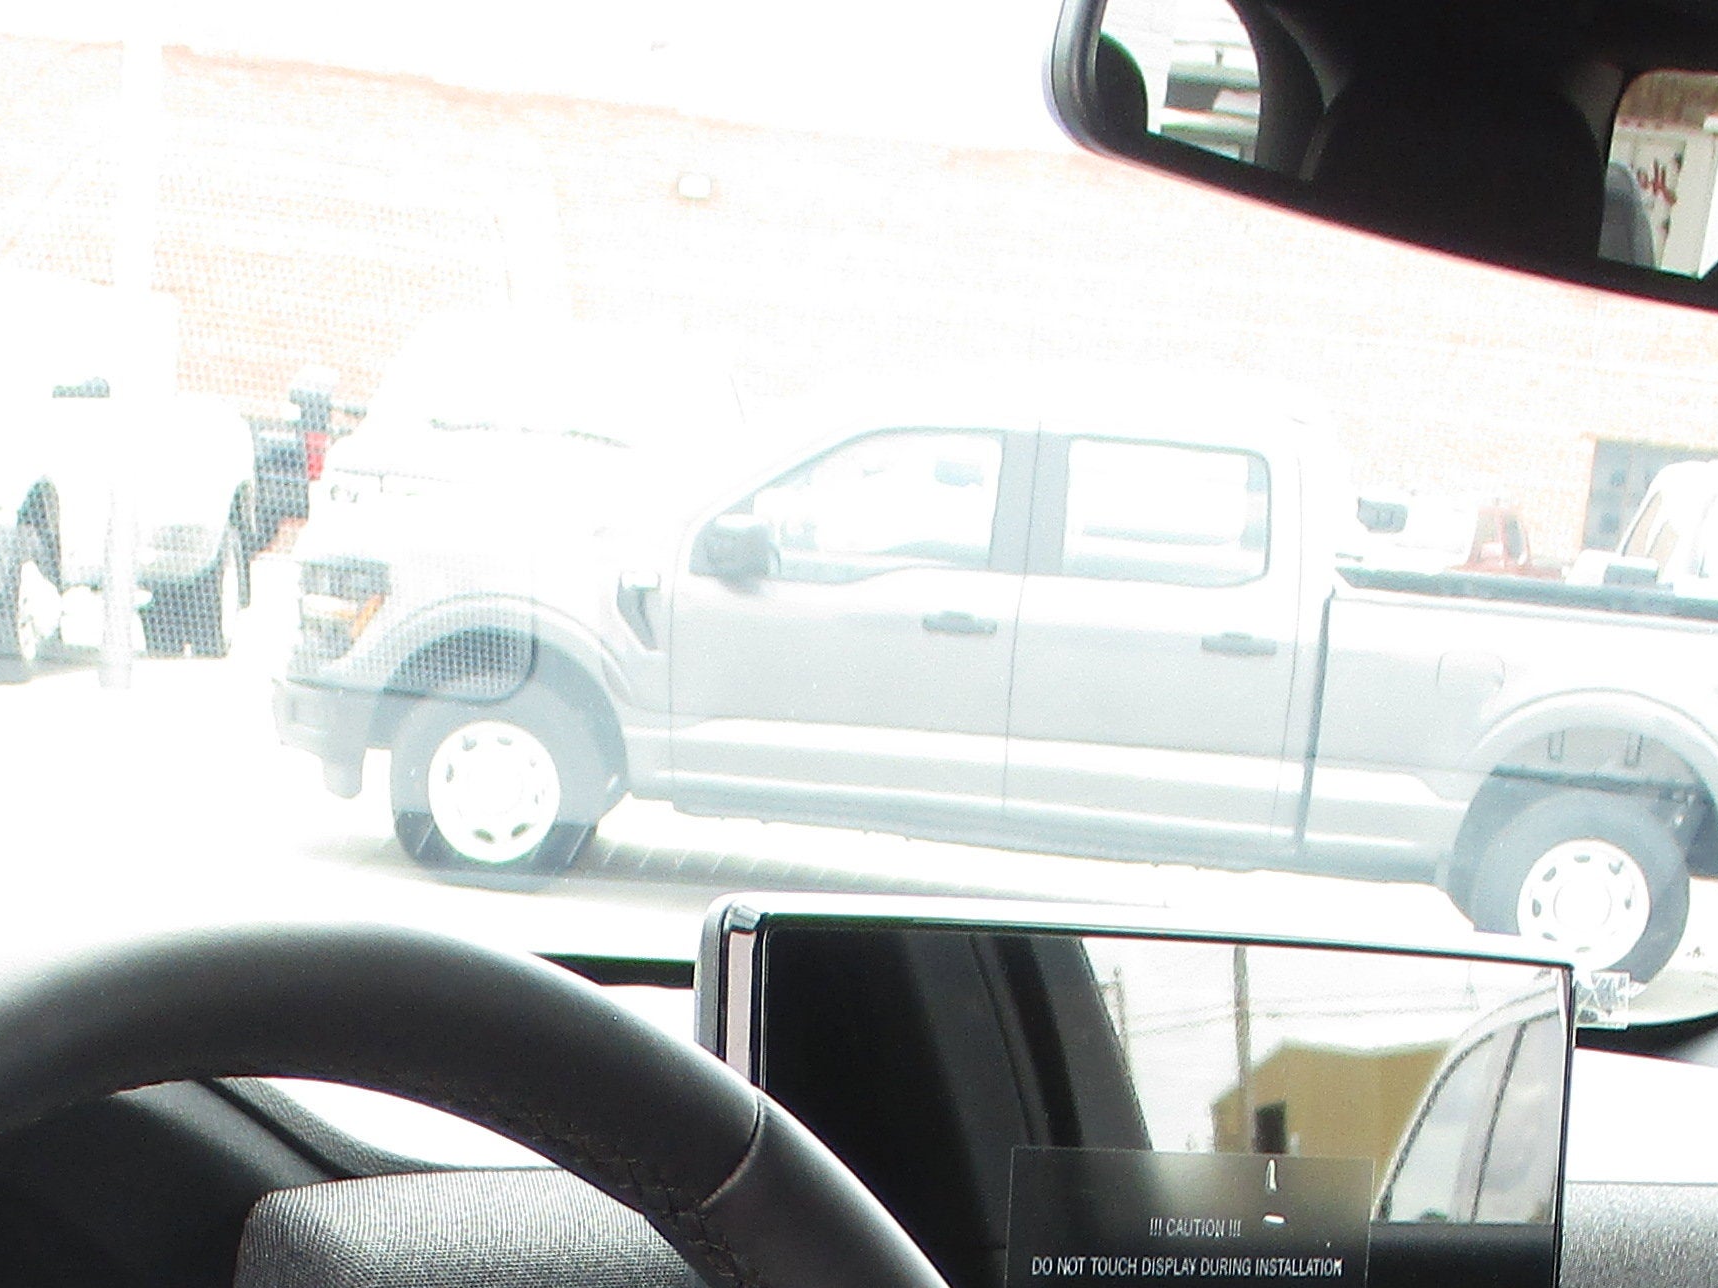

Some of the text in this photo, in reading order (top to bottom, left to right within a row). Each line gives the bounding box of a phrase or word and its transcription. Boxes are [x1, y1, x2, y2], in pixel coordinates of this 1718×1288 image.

[1165, 1217, 1225, 1238] CAUTION
[1031, 1256, 1344, 1278] DO NOT TOUCH DISPLAY DURING INSTALLATION
